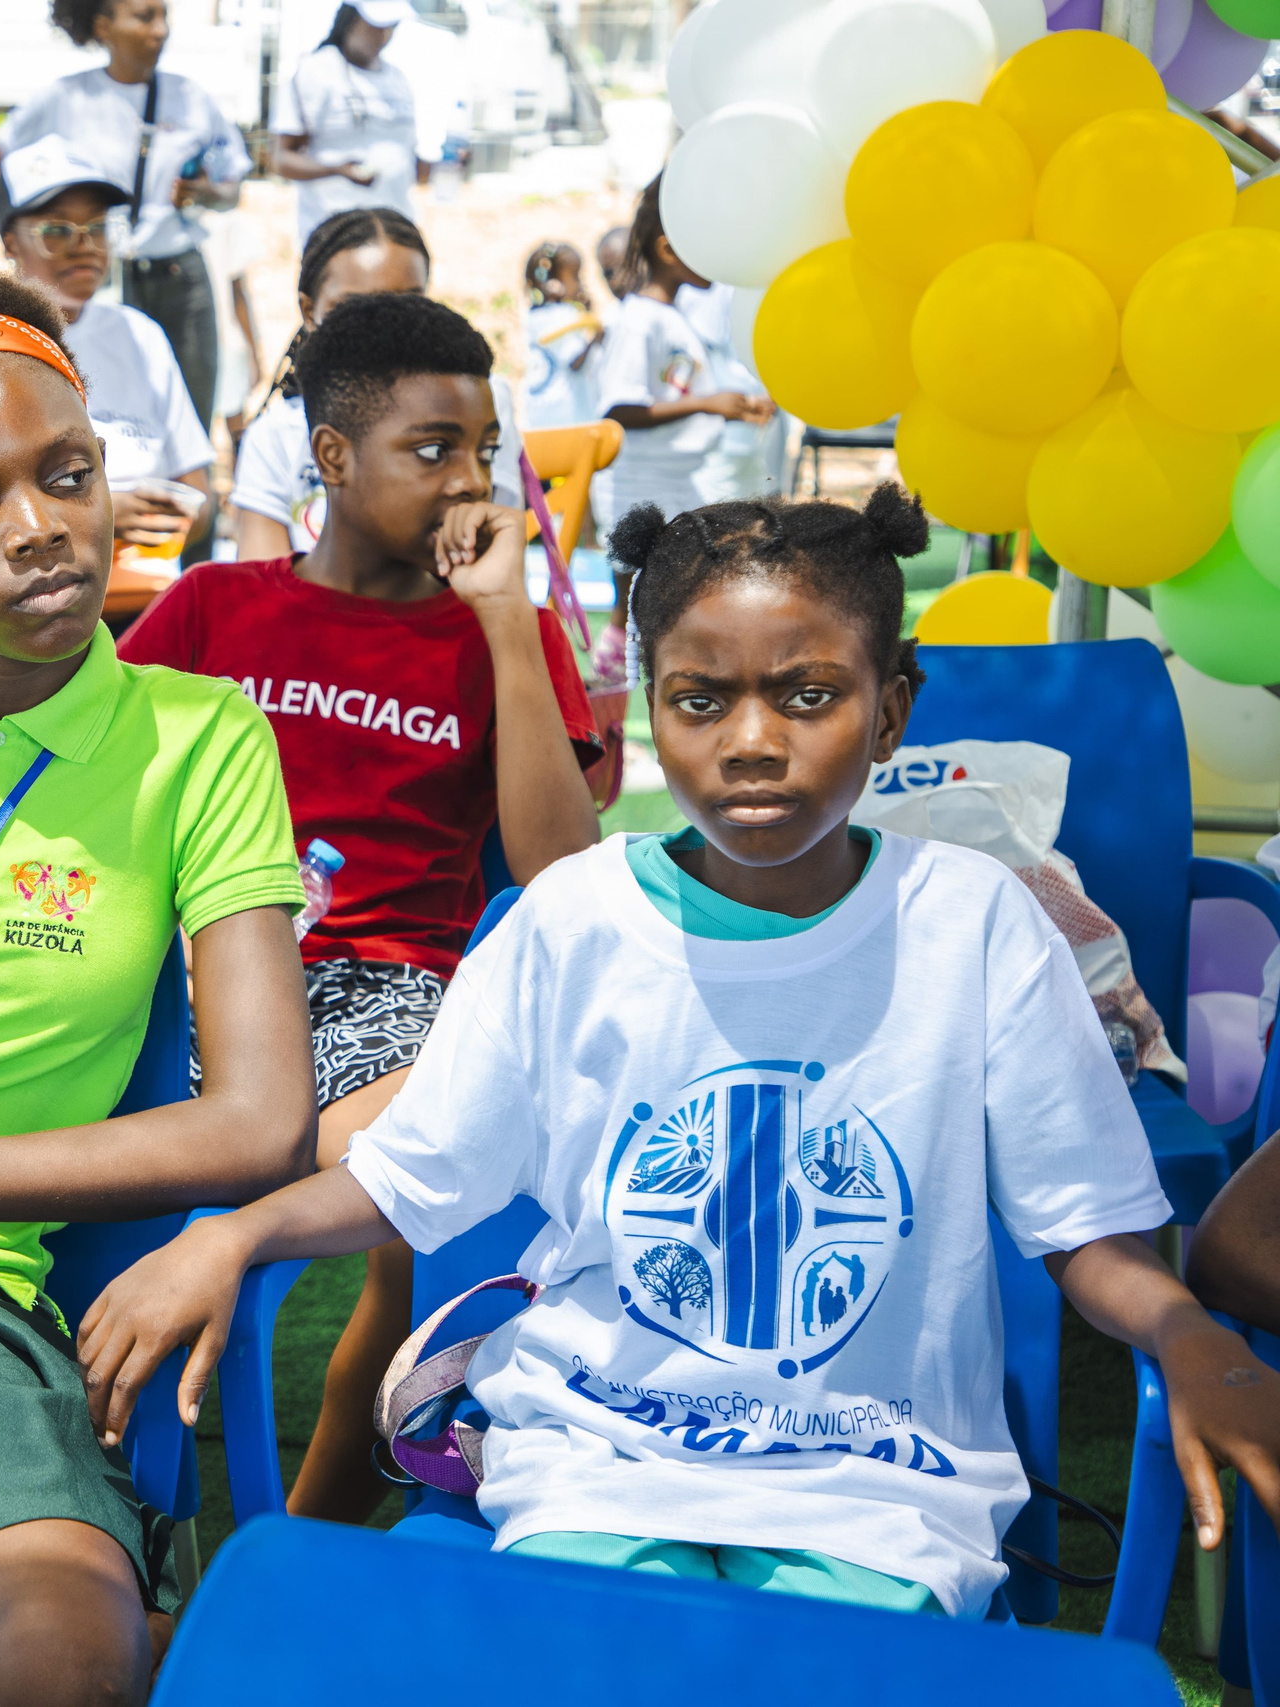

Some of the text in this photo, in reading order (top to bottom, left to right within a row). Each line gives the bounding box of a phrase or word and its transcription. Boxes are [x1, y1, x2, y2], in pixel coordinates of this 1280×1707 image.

[219, 675, 462, 751] ALENCIAGA
[3, 929, 83, 956] KUZOLA
[6, 919, 85, 936] LAR DE INFÂNCIA
[769, 1404, 889, 1437] MUNICIPAL
[889, 1398, 913, 1426] DA
